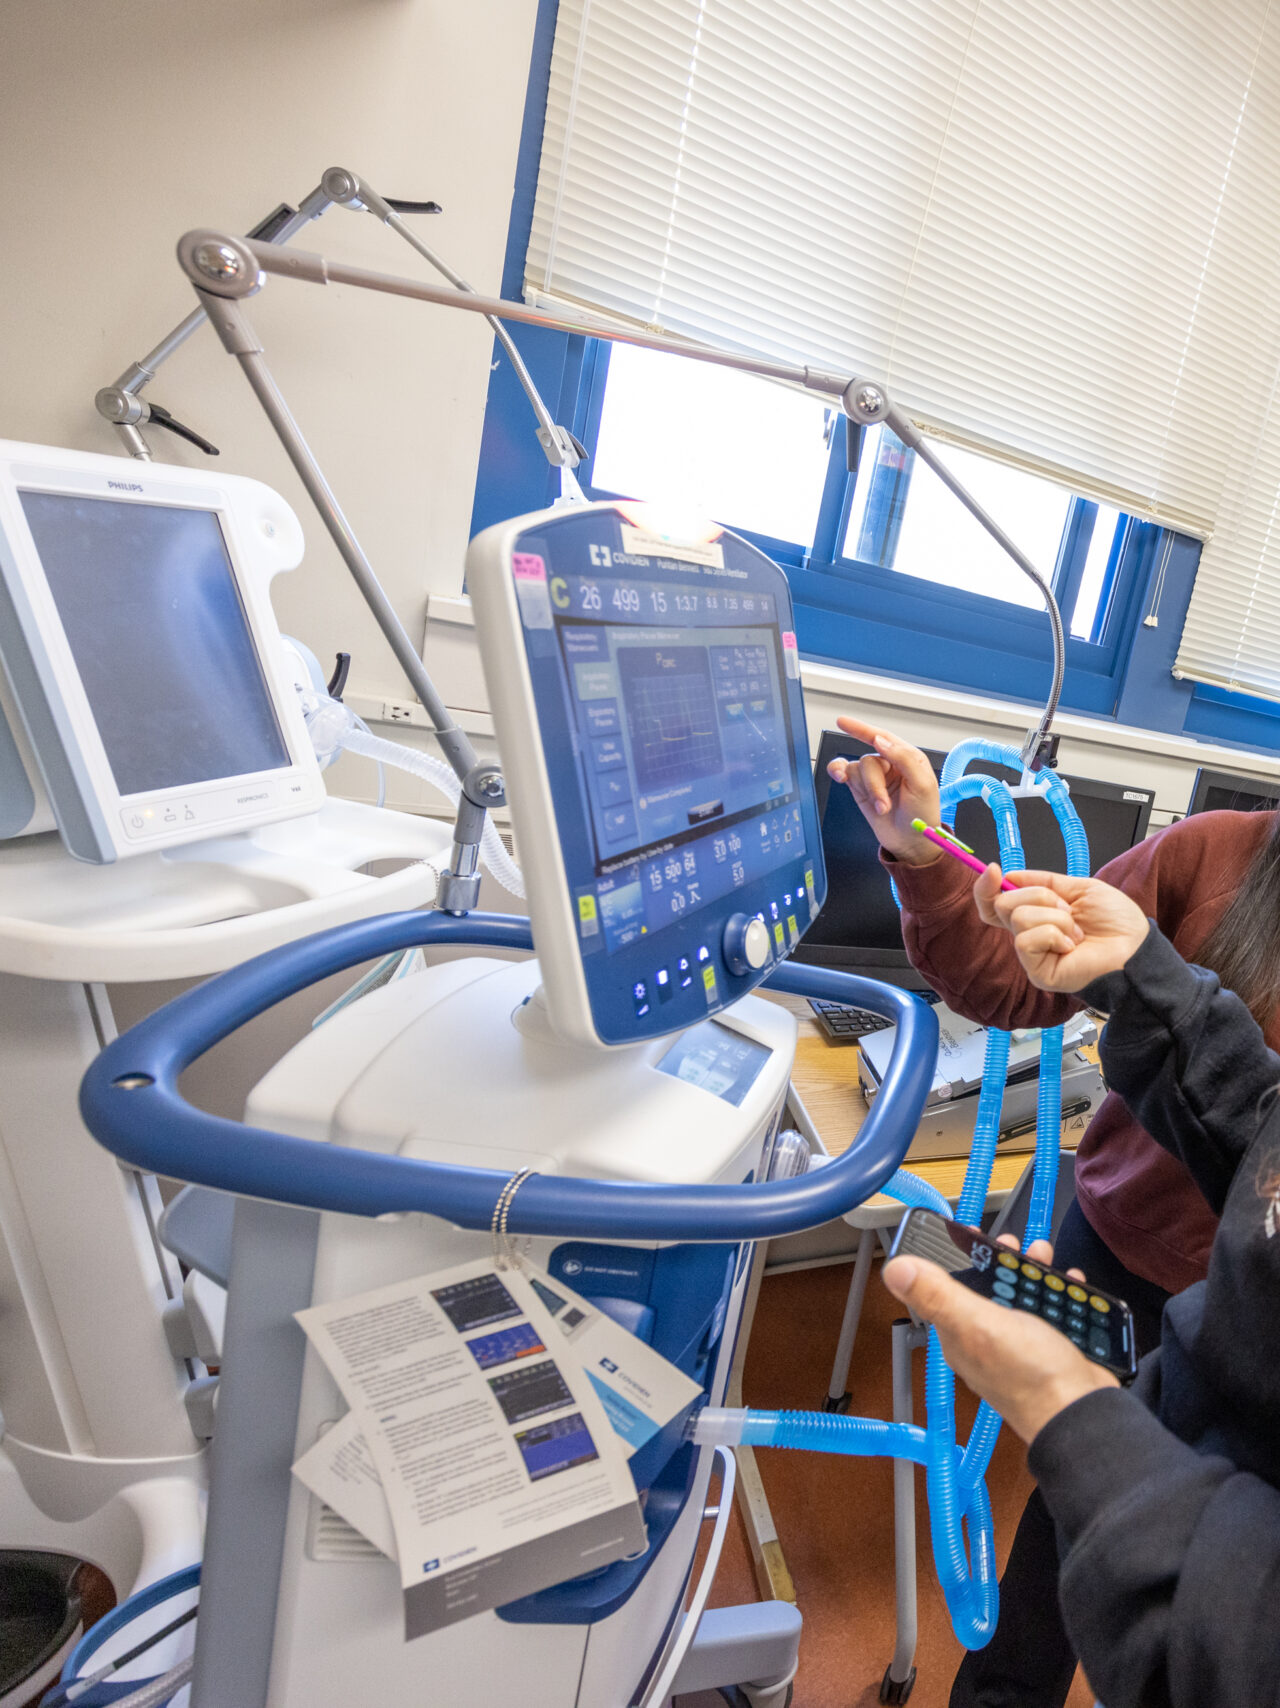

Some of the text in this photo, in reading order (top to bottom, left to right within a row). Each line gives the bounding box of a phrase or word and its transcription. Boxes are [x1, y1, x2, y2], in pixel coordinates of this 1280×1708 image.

[107, 480, 144, 492] PHILIPS
[613, 551, 651, 568] COVIDIEN
[579, 585, 602, 610] 26
[612, 588, 641, 613] 499
[651, 591, 668, 613] 15
[650, 870, 662, 886] 15
[664, 861, 682, 880] 500
[728, 837, 742, 852] 100
[671, 893, 686, 912] 0.0
[617, 1371, 652, 1399] COVIDIEN
